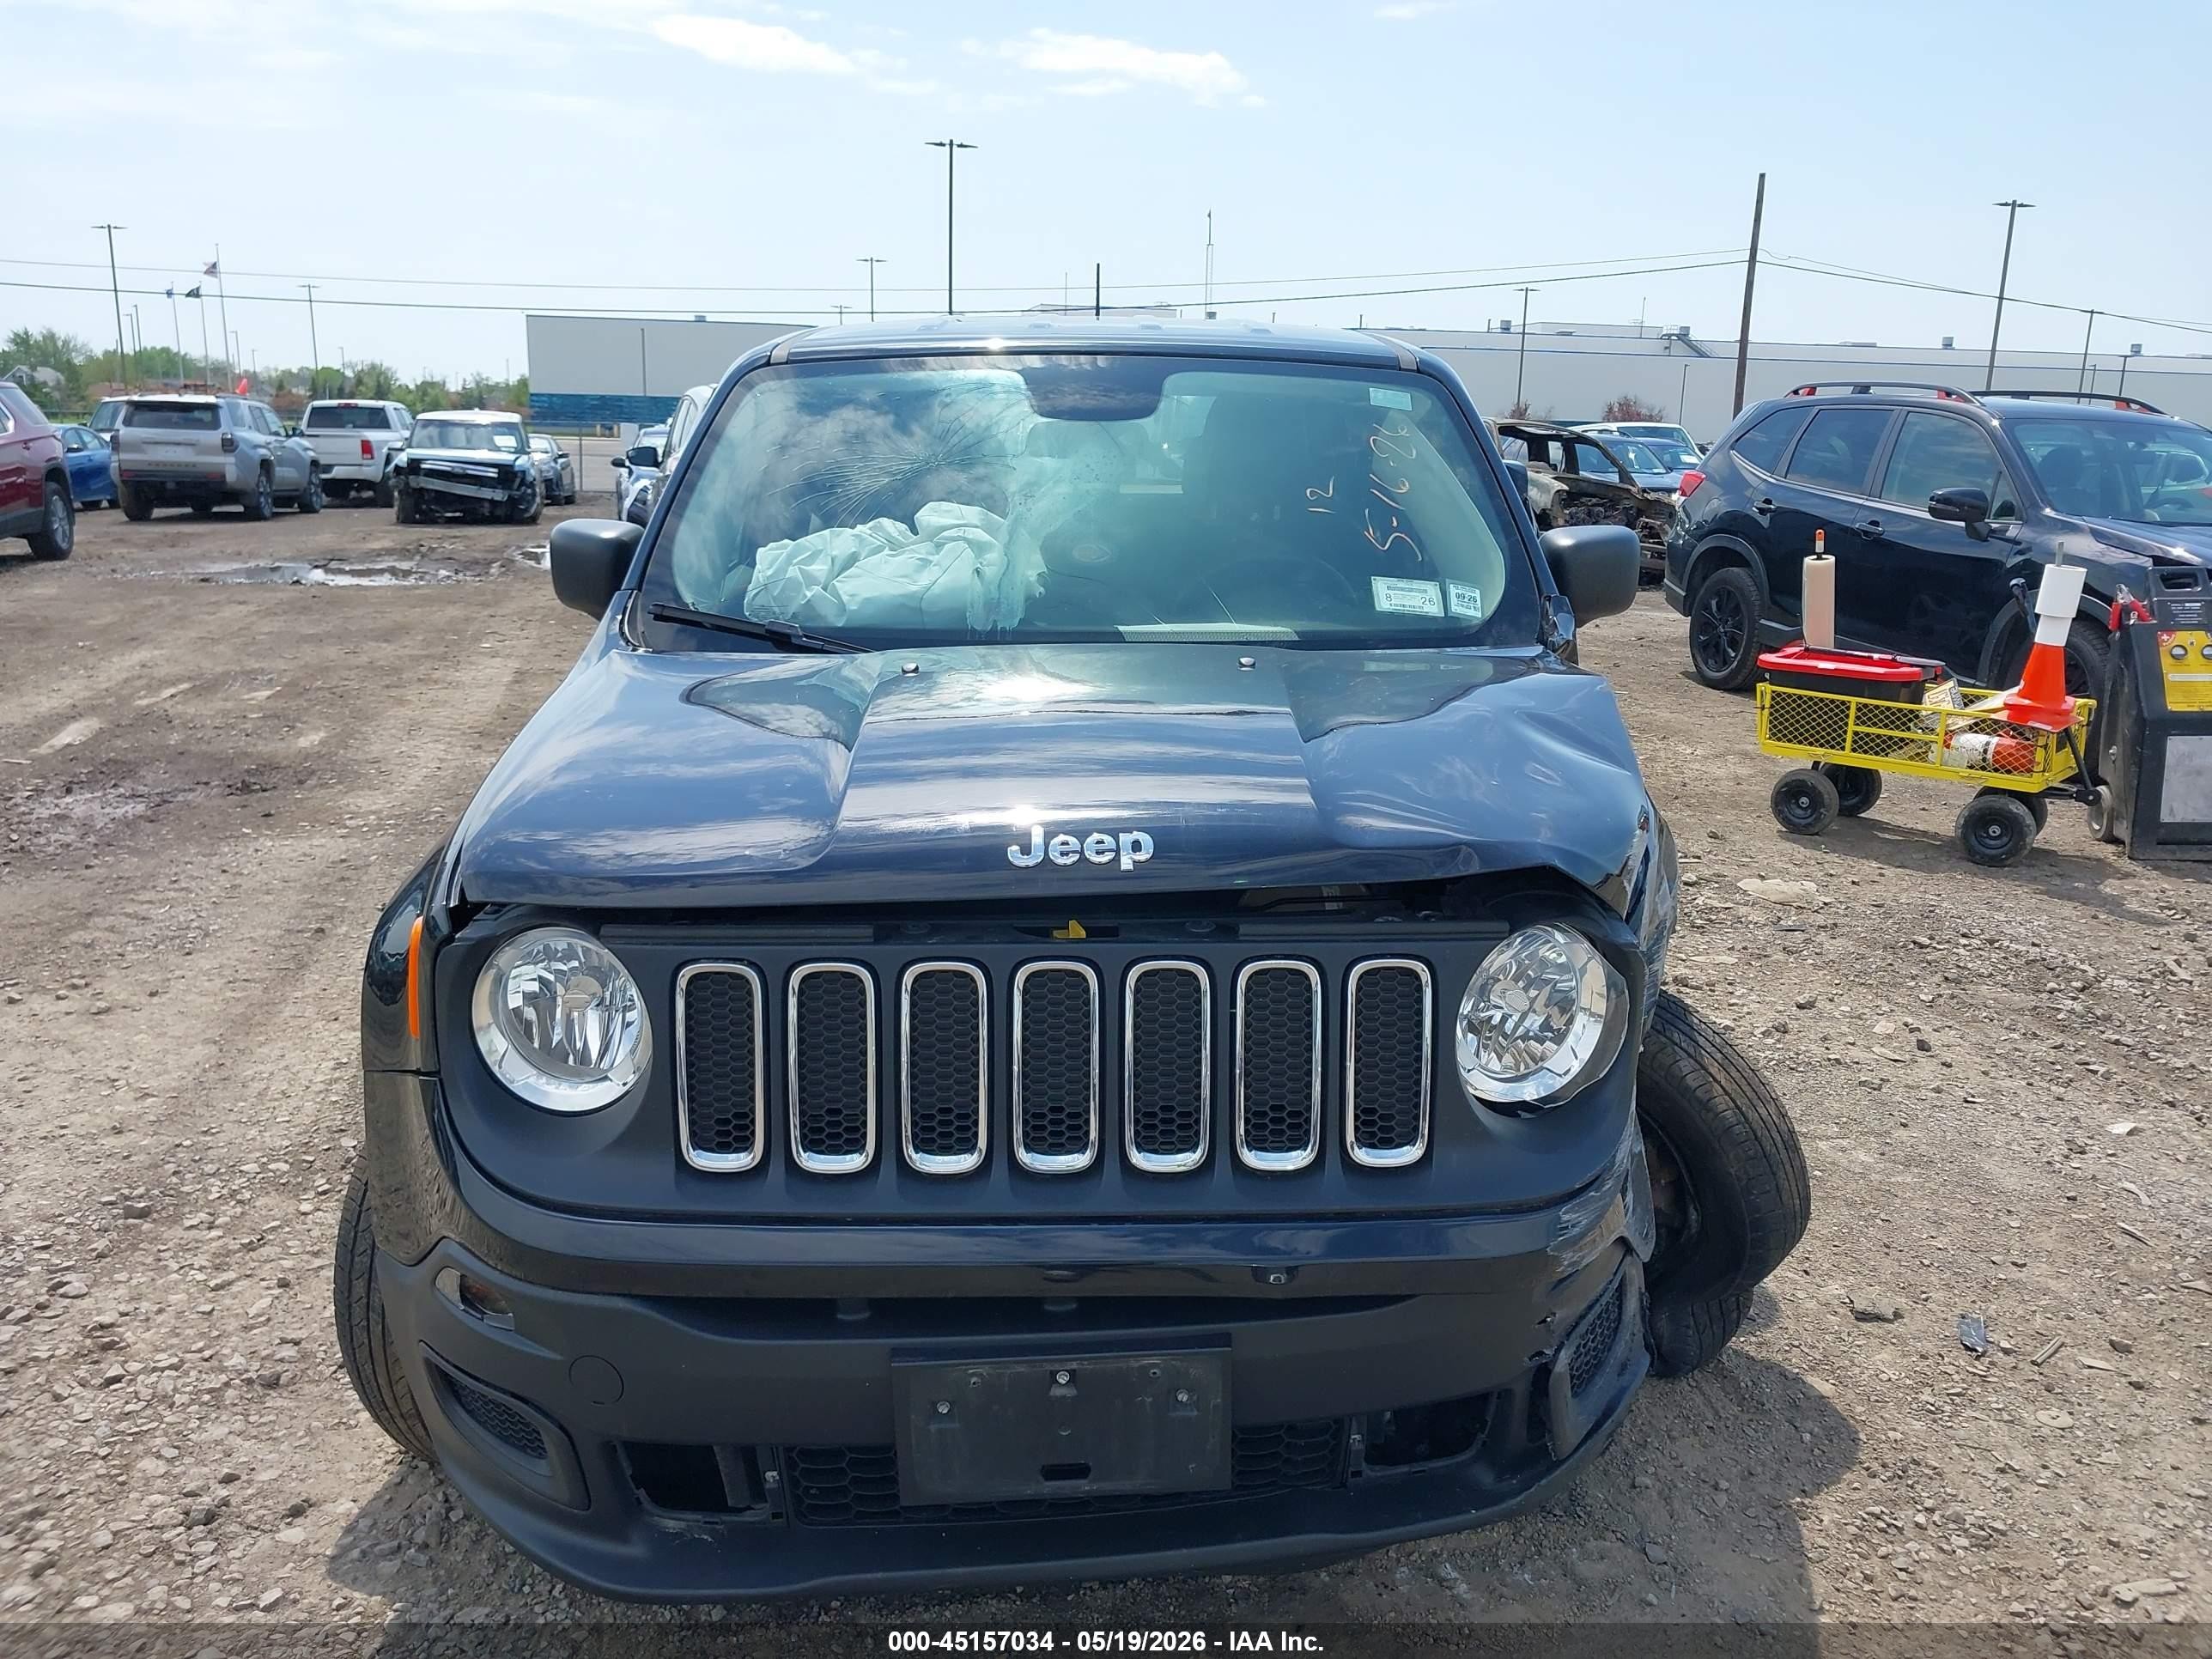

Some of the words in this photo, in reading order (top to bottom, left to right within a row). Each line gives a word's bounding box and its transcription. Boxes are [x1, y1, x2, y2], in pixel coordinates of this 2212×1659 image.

[1384, 592, 1393, 603] 8
[1420, 596, 1437, 606] 26
[1007, 824, 1155, 872] Jeep
